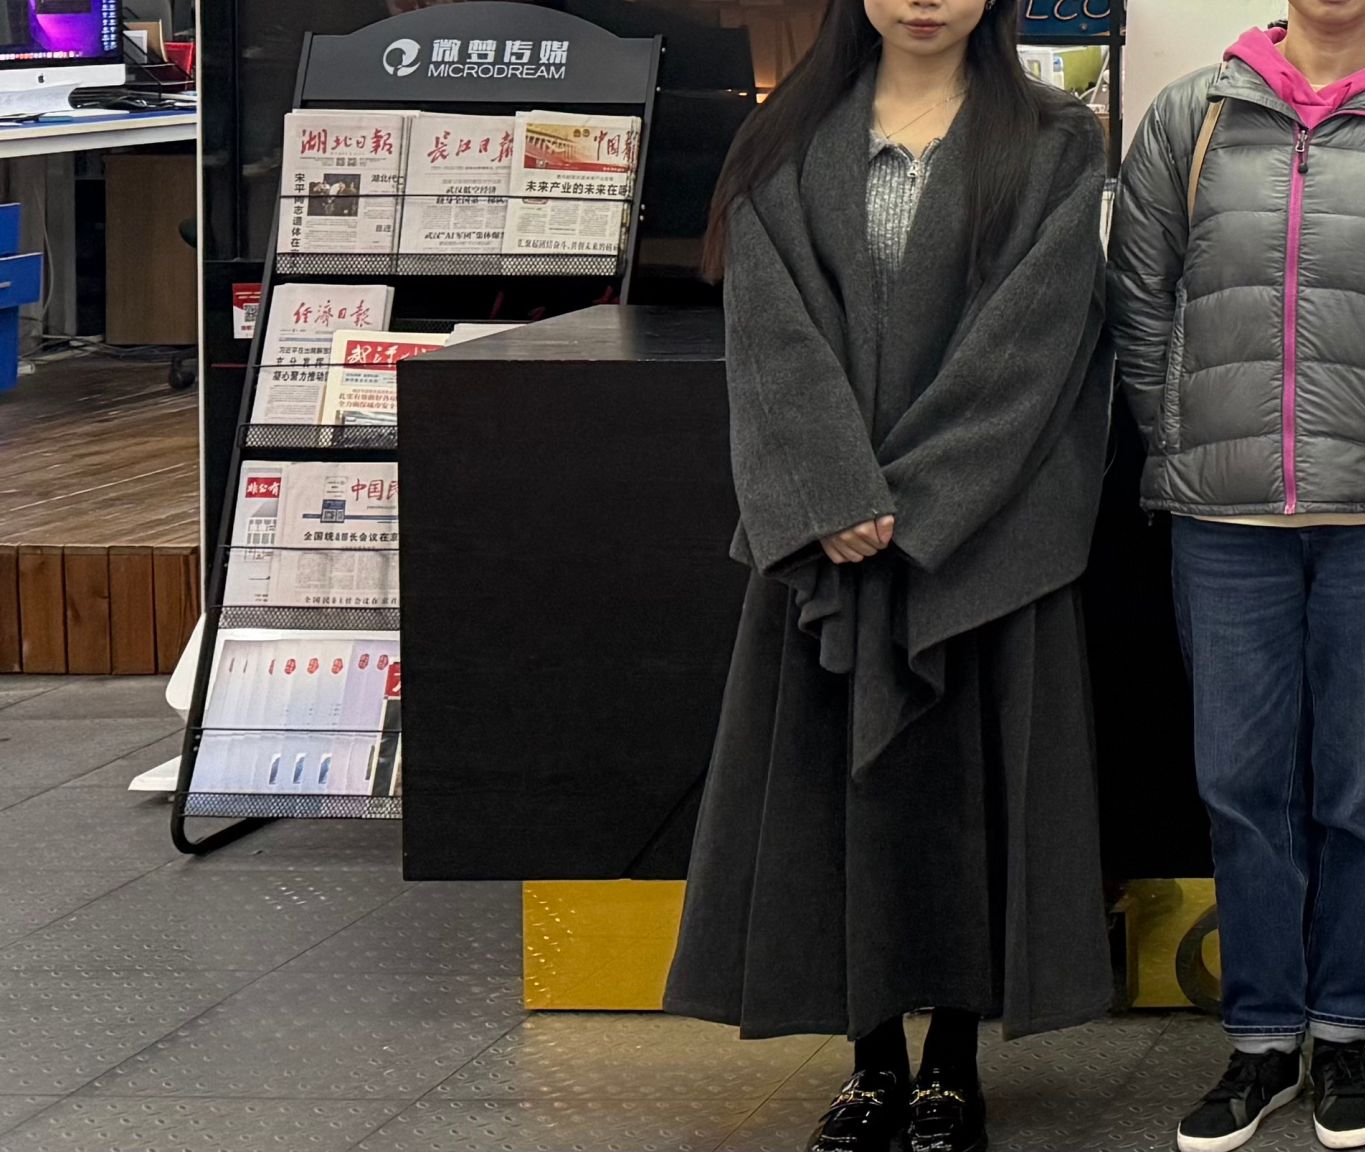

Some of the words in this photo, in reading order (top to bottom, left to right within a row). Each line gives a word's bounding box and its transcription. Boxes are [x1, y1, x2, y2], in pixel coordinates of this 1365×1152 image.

[432, 38, 570, 64] 微梦传媒
[427, 64, 566, 79] MICRODREAM
